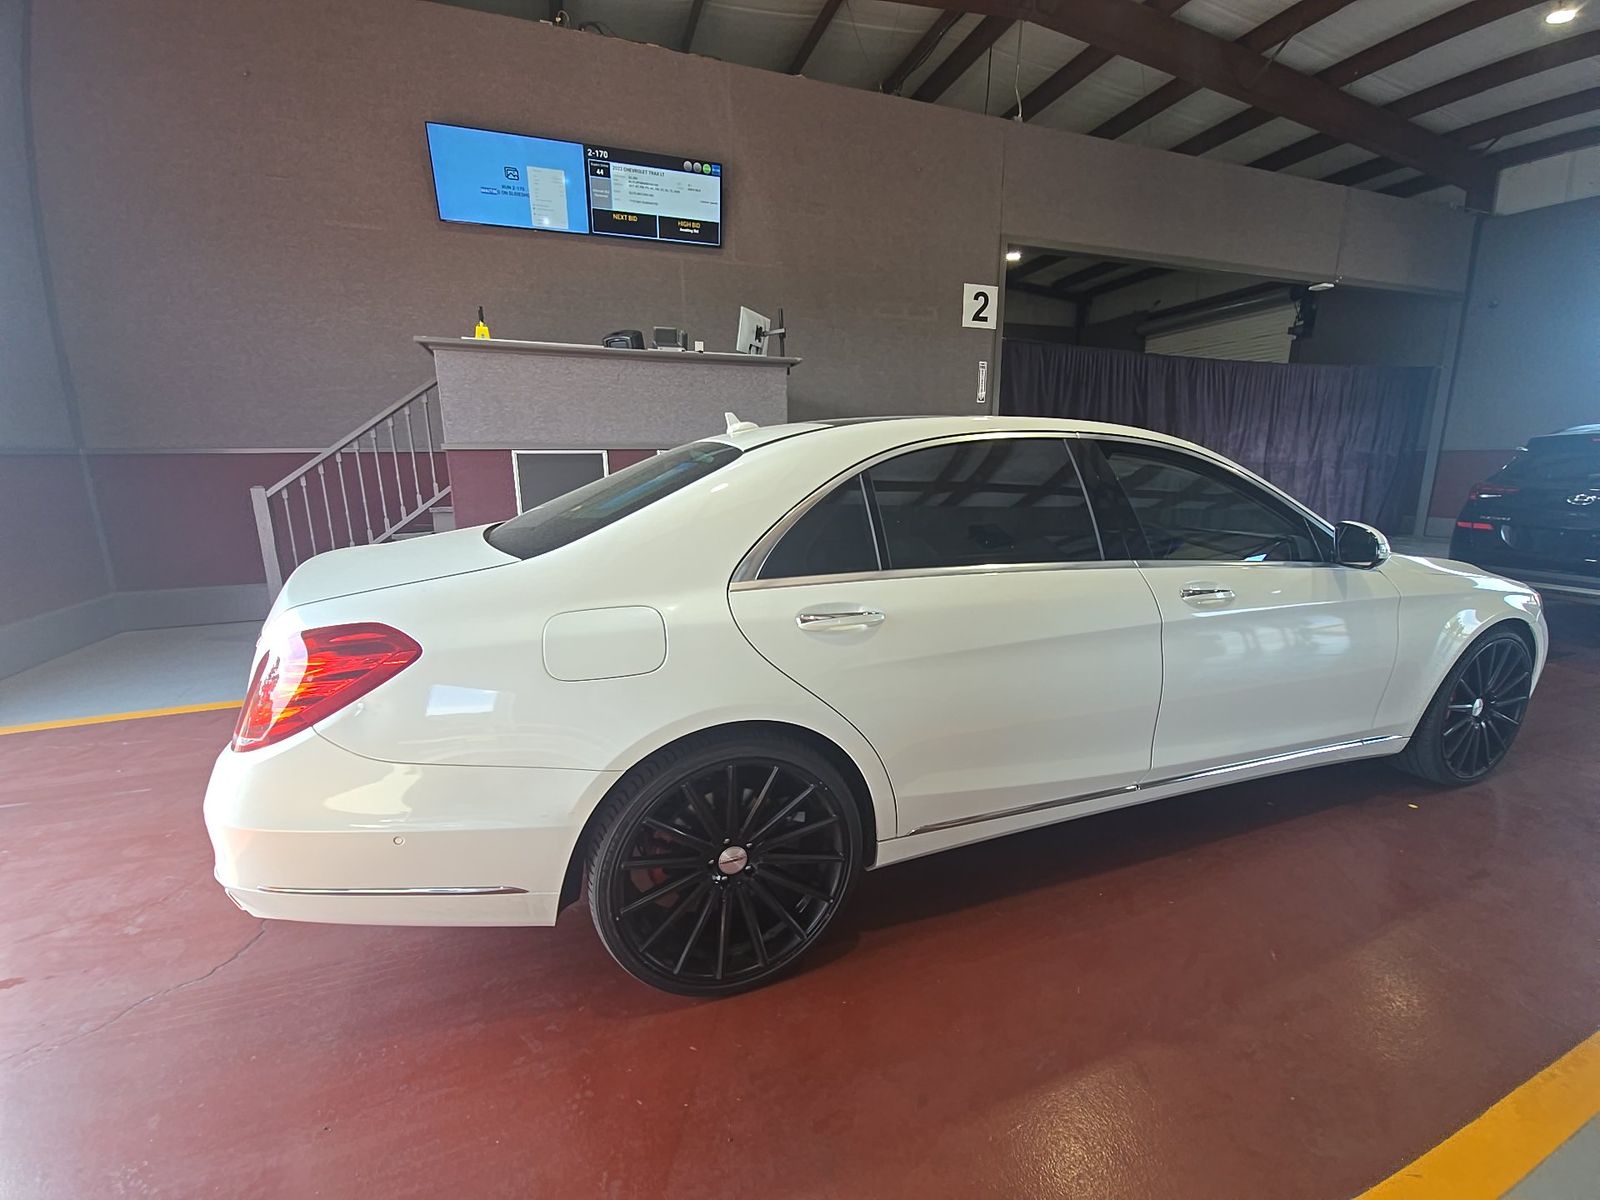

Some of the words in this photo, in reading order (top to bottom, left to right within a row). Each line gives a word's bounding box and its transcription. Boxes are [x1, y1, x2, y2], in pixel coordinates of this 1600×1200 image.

[587, 148, 609, 159] 2-170
[596, 168, 604, 176] 44
[623, 167, 648, 175] CHEVROLET
[612, 213, 628, 221] NEXT
[972, 291, 989, 322] 2
